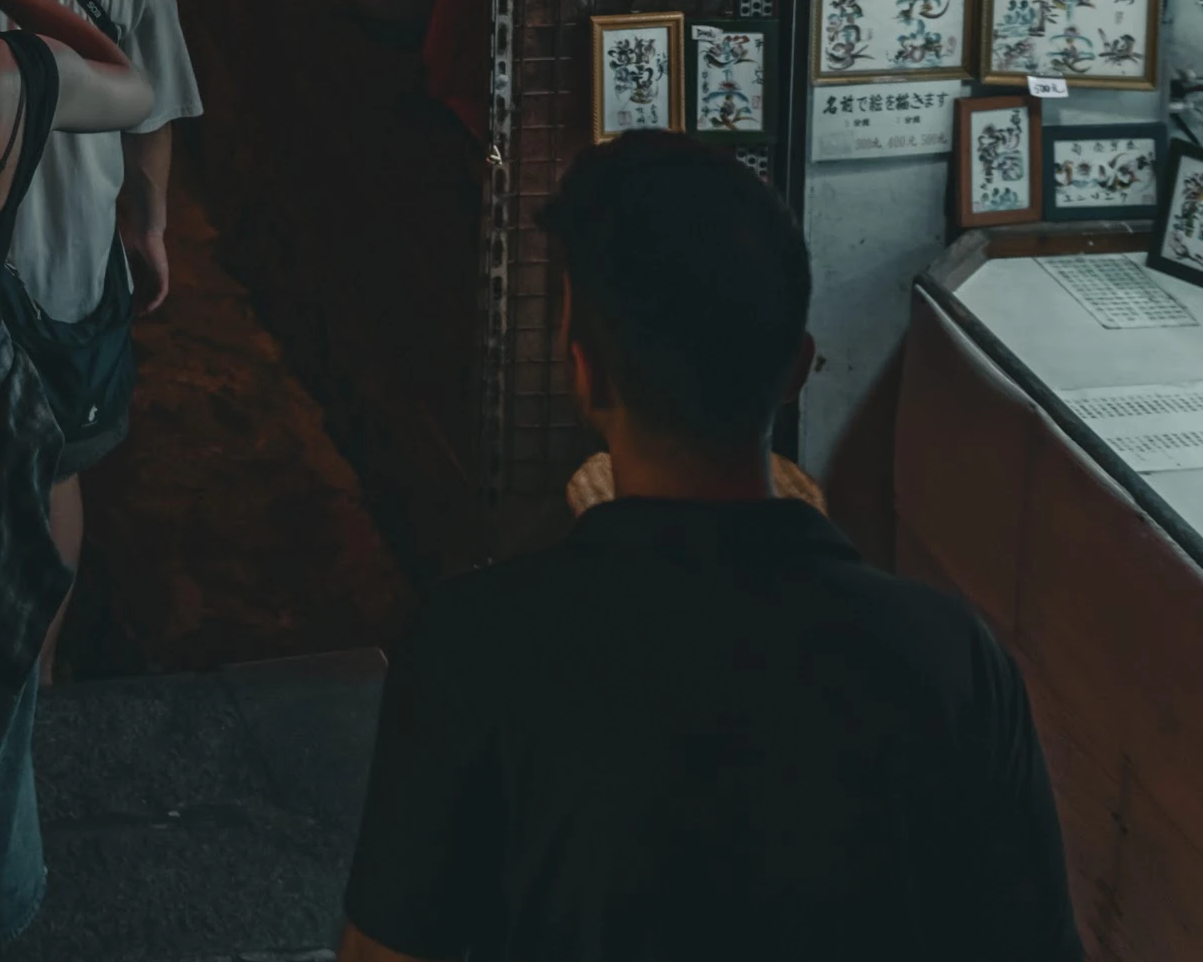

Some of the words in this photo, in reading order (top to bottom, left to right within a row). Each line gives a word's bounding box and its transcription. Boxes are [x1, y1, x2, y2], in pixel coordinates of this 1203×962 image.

[823, 91, 949, 115] 名前で絵を描きます
